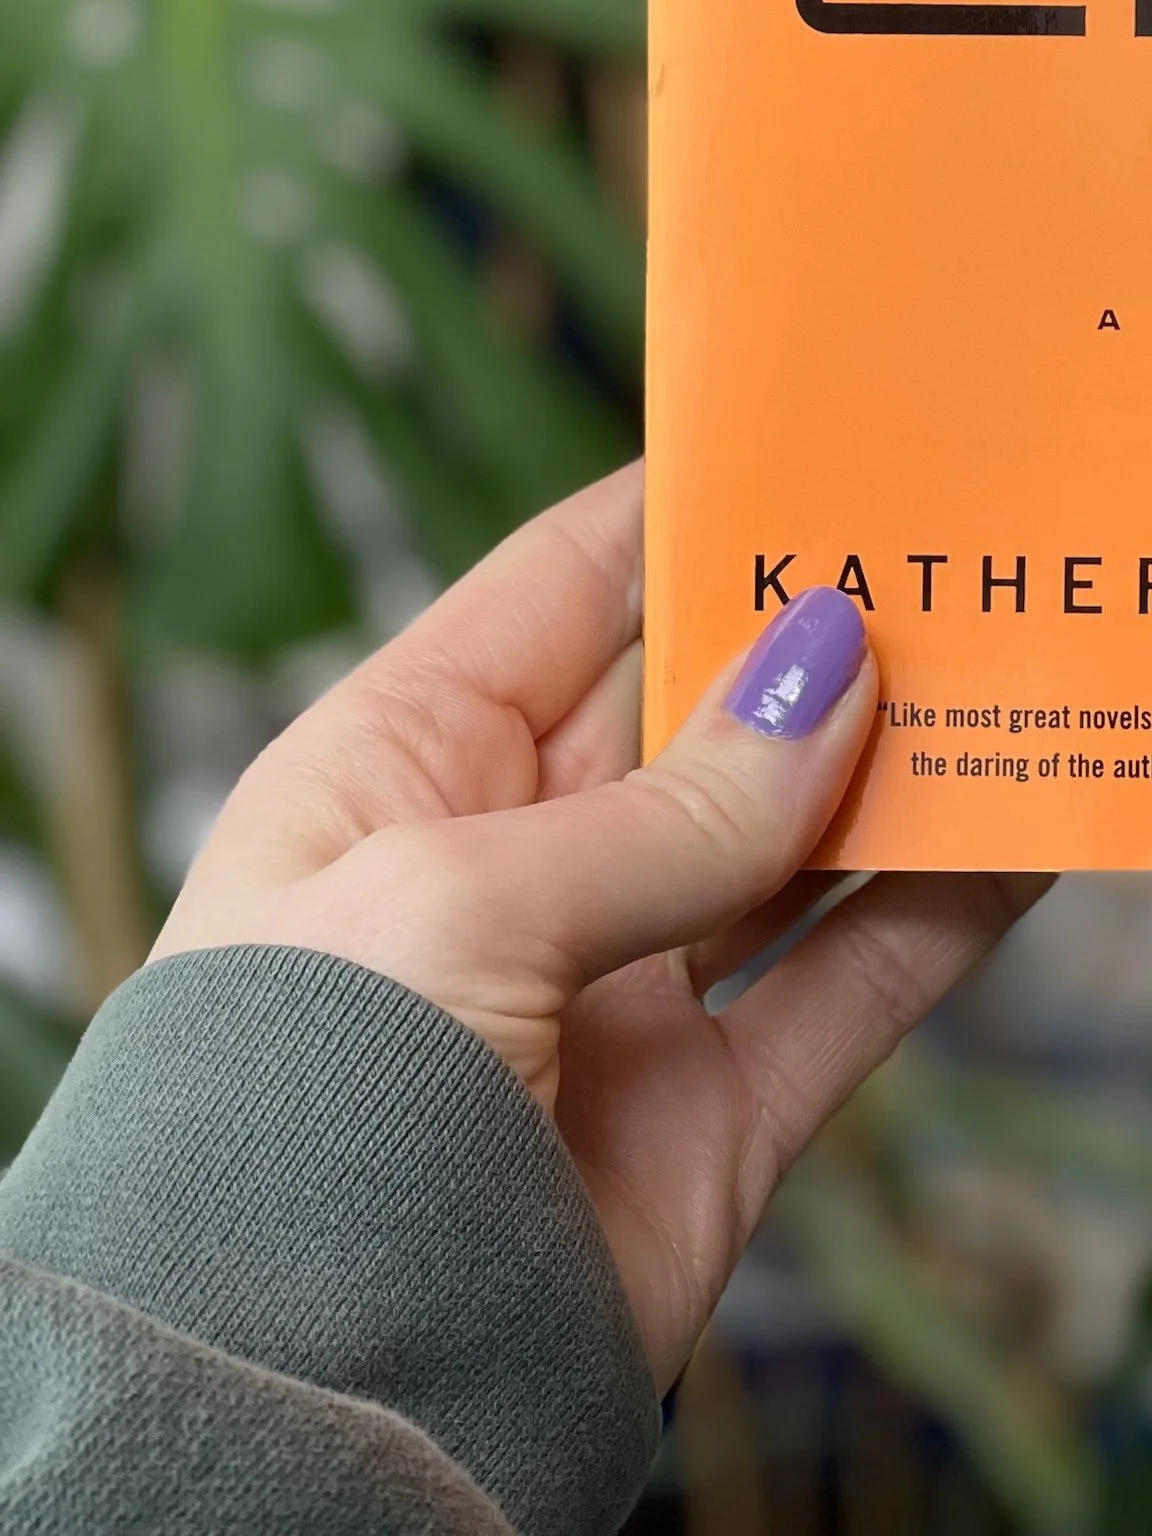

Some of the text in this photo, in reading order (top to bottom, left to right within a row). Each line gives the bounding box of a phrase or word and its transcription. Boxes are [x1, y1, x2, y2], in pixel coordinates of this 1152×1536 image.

[1098, 310, 1121, 330] A
[946, 705, 1001, 729] most
[1009, 705, 1071, 734] great
[910, 751, 947, 776] the
[956, 752, 1029, 782] daring
[1038, 752, 1060, 777] of
[1068, 753, 1104, 778] the
